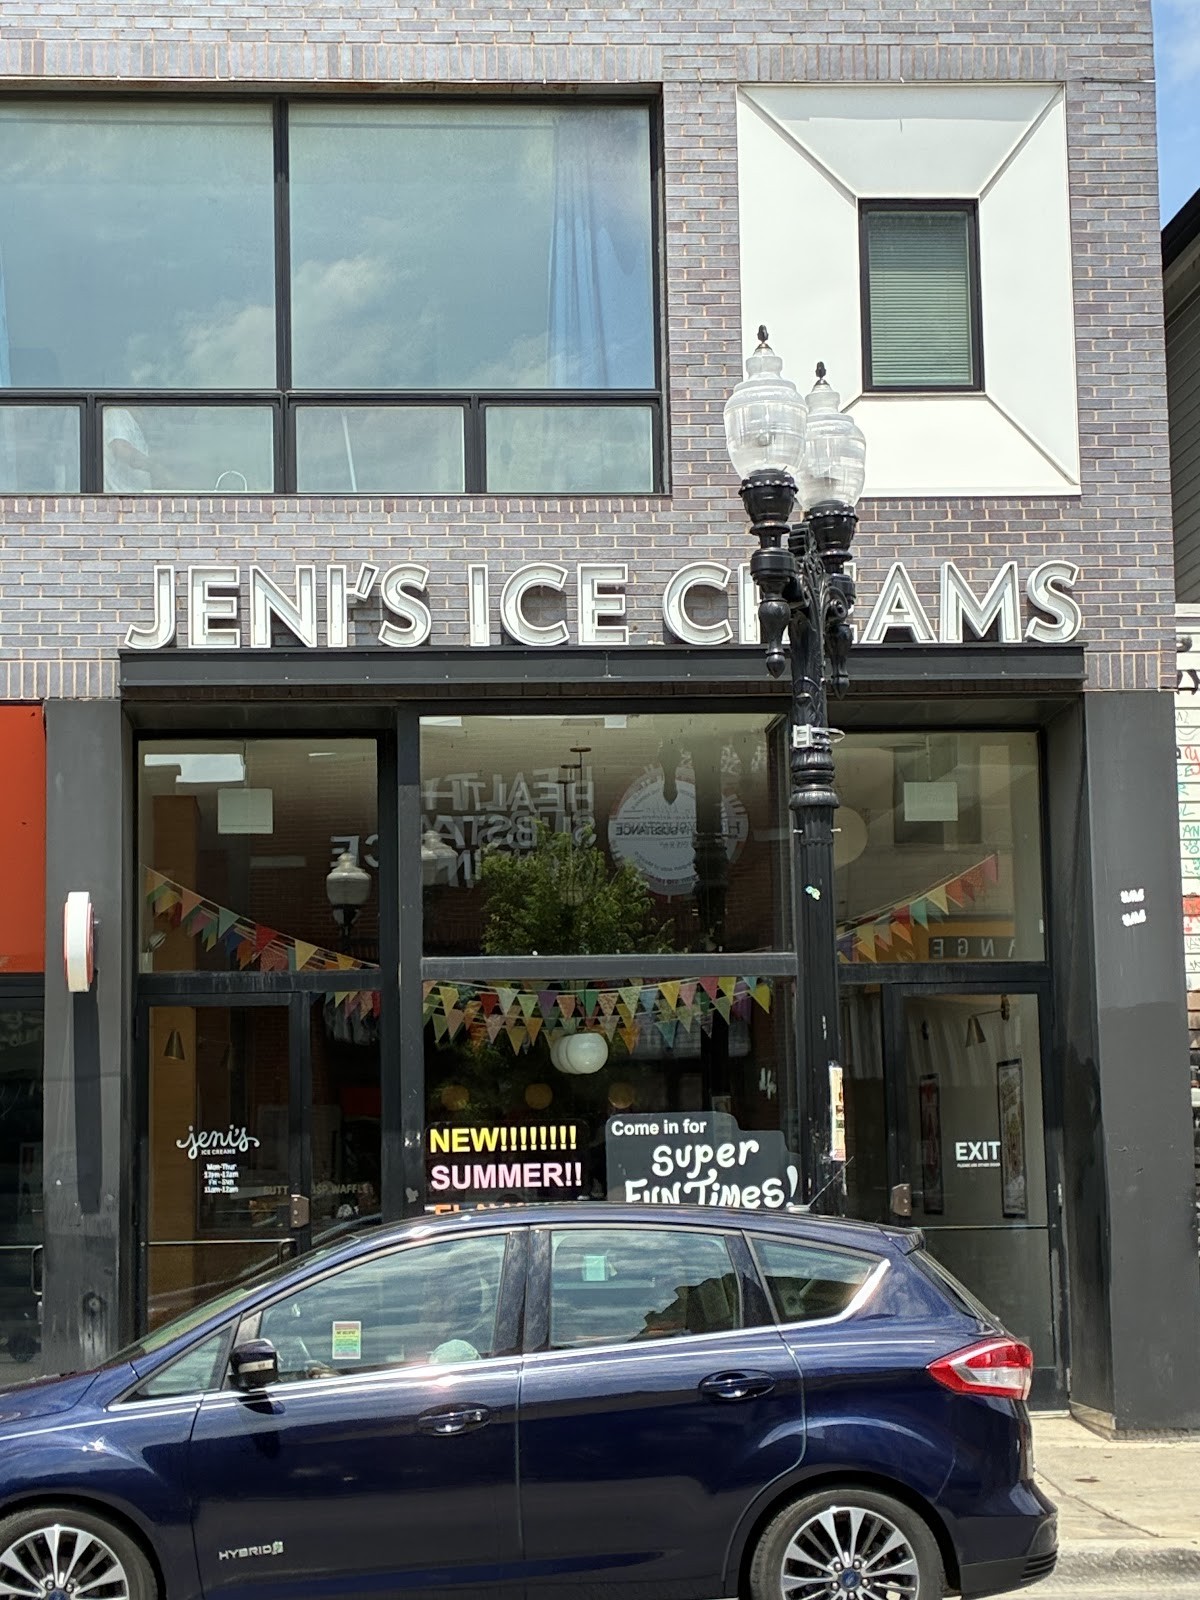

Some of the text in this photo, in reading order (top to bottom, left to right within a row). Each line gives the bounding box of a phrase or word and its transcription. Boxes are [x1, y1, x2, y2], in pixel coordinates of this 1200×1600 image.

[124, 559, 1082, 649] JENI'S ICE CAMS
[430, 1125, 577, 1153] NEW!!!!!!!!
[611, 1118, 707, 1136] Come in for
[652, 1140, 760, 1179] Super
[955, 1141, 1001, 1161] EXIT
[431, 1162, 582, 1191] SUMMER!!
[219, 1545, 272, 1560] HYBRID
